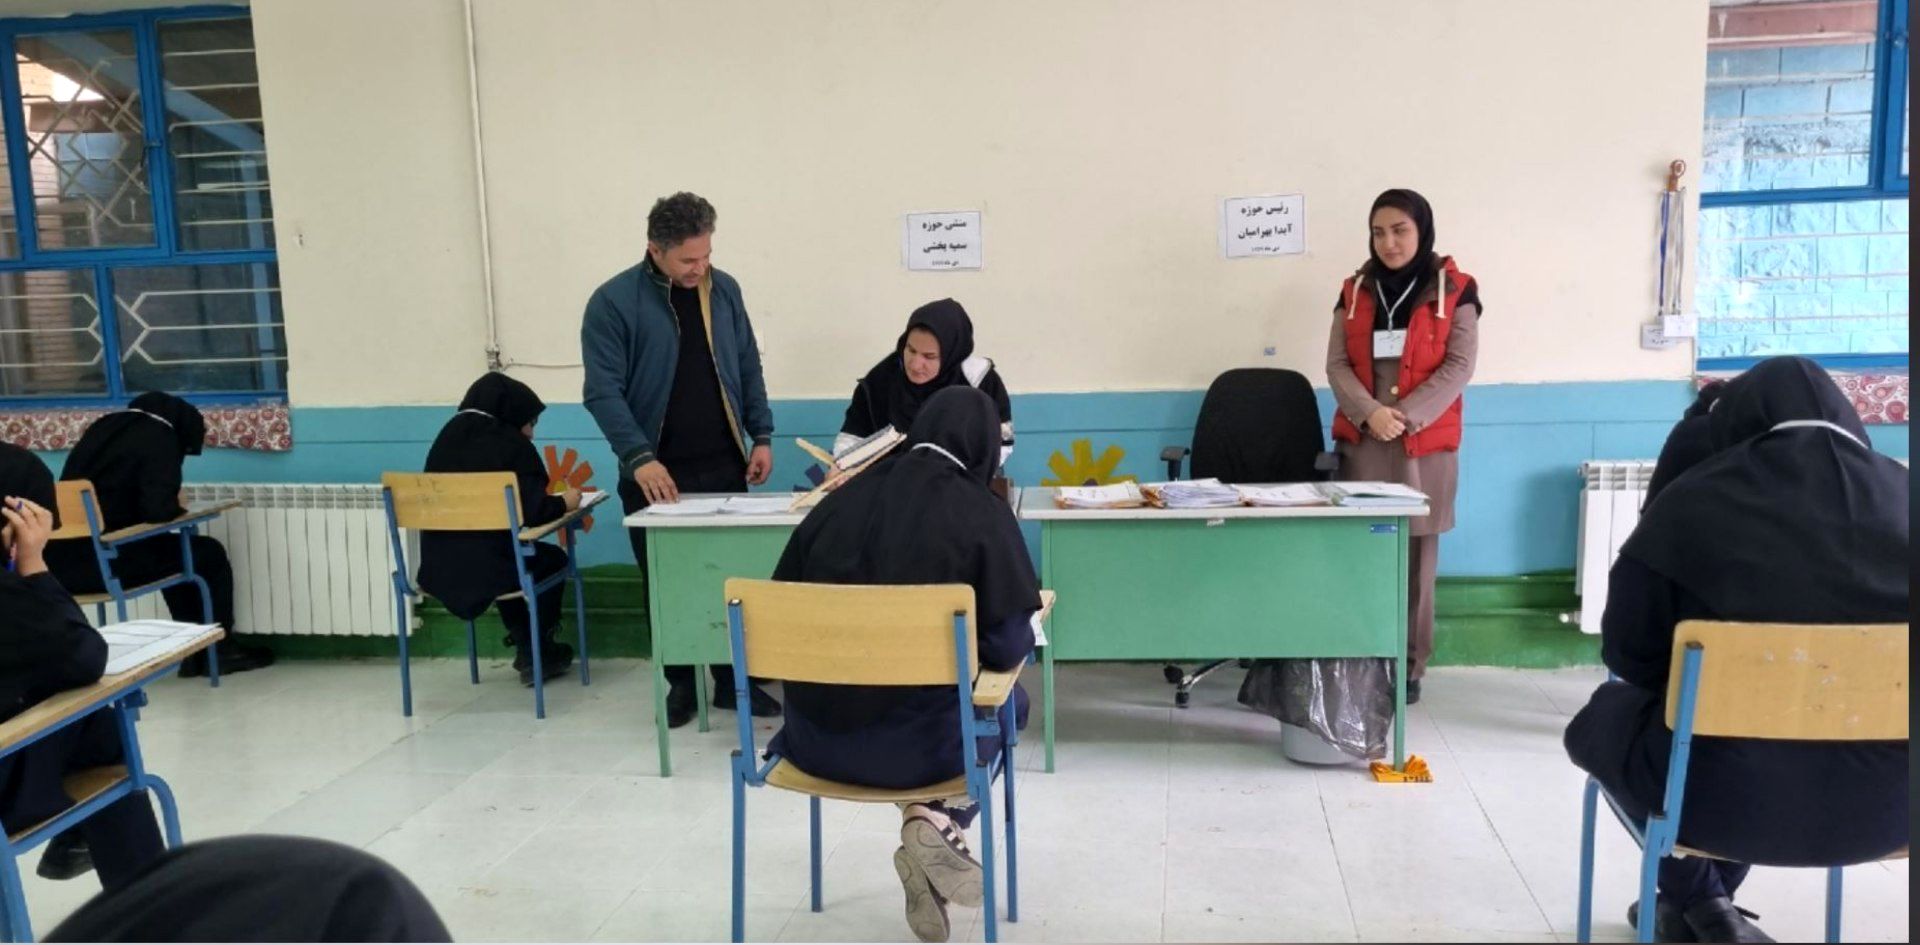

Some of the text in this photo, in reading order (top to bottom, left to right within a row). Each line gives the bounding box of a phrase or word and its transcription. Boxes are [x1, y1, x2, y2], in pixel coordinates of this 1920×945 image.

[1241, 205, 1263, 217] حوزه
[922, 219, 967, 232] منشی حوزه
